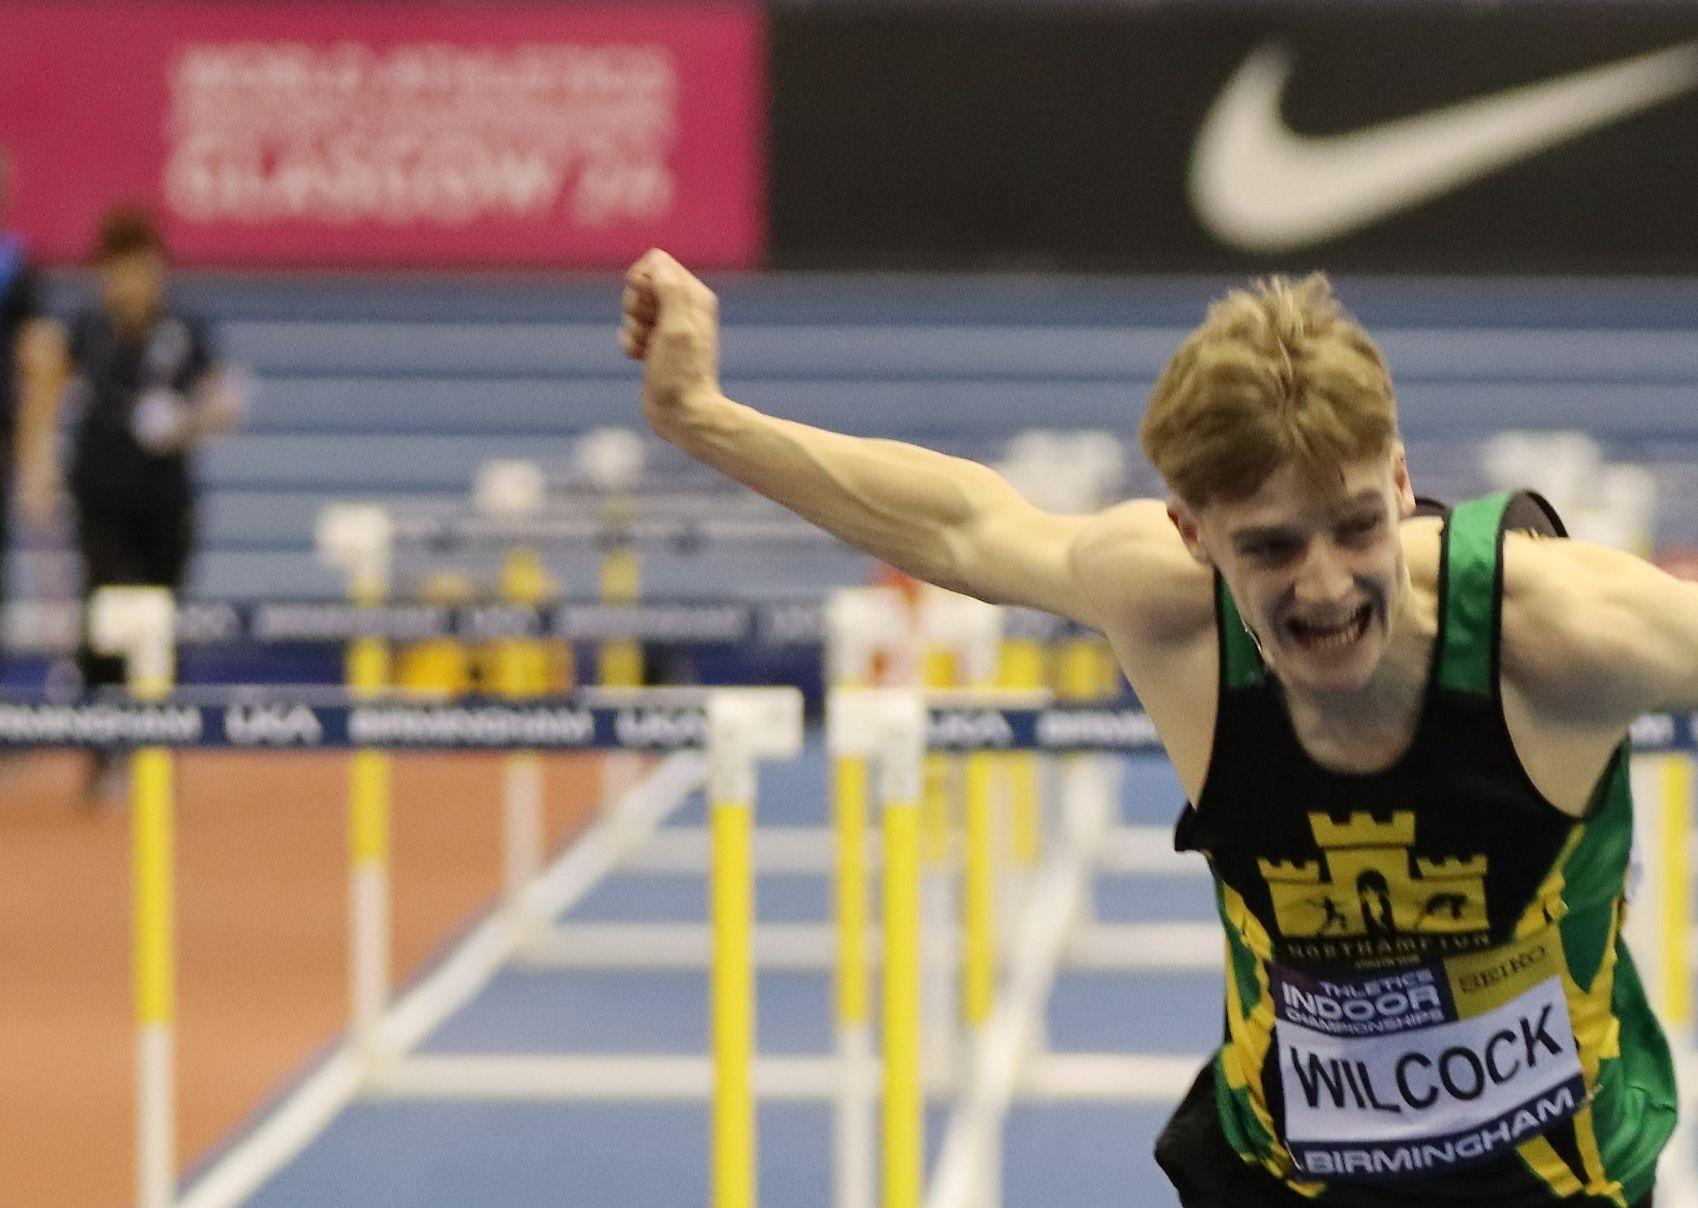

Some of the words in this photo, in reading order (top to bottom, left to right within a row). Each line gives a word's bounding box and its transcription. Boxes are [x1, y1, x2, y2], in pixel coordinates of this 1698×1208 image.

[1281, 980, 1442, 1022] INDOOR
[1459, 944, 1547, 994] SEIKO
[1290, 1003, 1564, 1113] WILCOCK
[1301, 1086, 1576, 1174] BIRMINGHAM
